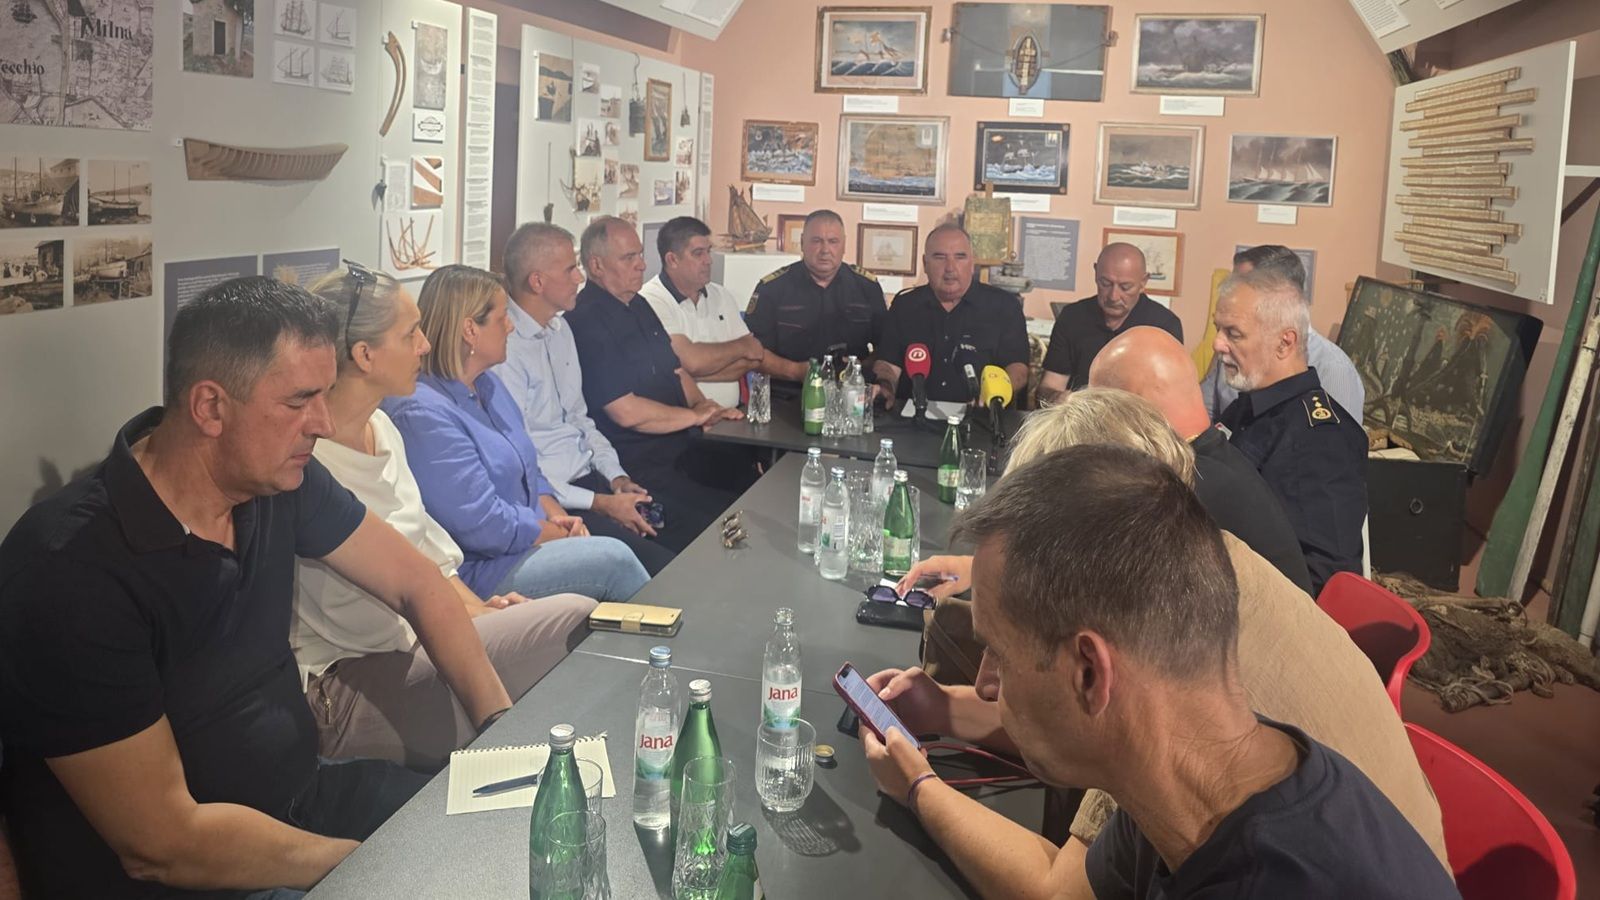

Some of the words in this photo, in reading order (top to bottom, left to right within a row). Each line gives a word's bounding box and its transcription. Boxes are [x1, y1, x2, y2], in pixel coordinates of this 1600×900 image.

[80, 17, 133, 40] Milna
[0, 58, 45, 75] ecchio
[768, 687, 798, 700] Jana
[640, 734, 673, 749] Jana
